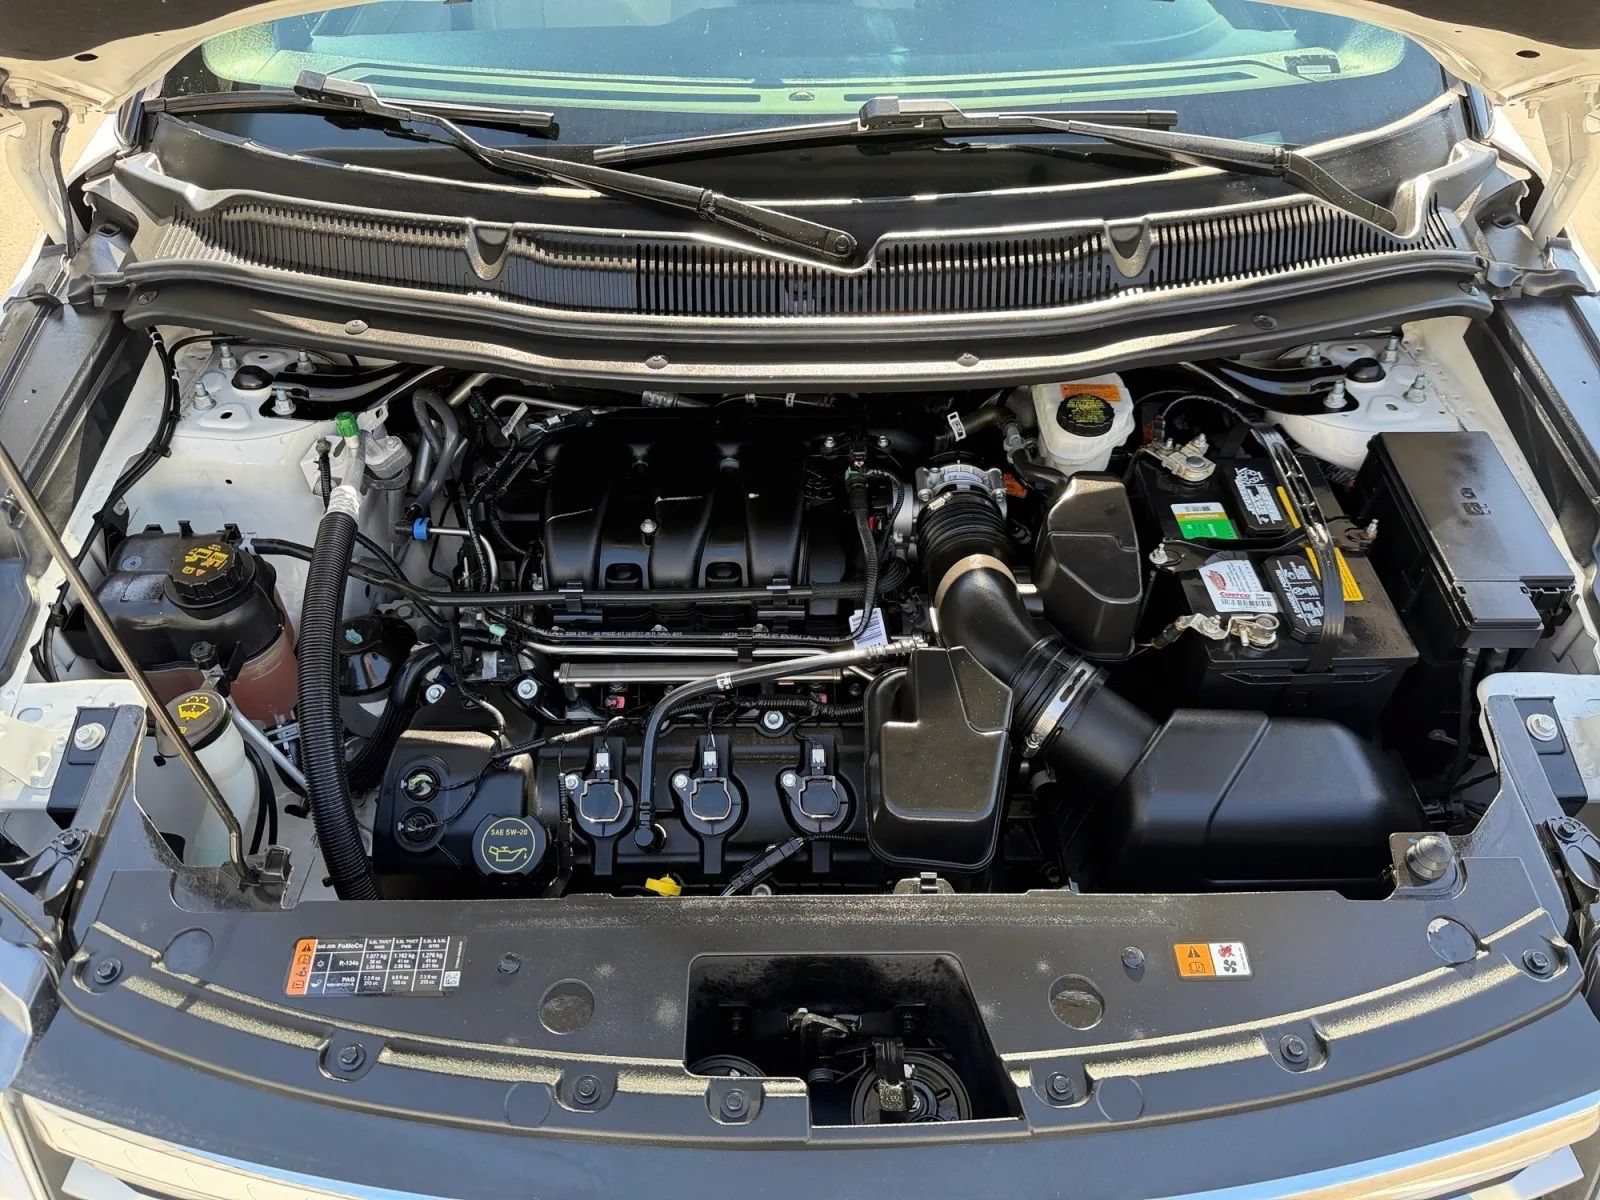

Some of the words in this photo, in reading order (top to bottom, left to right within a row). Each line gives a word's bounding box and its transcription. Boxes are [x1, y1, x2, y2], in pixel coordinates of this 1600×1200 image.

[1219, 591, 1251, 599] COSTCO
[490, 828, 504, 836] SAE
[505, 828, 528, 836] 5W-20
